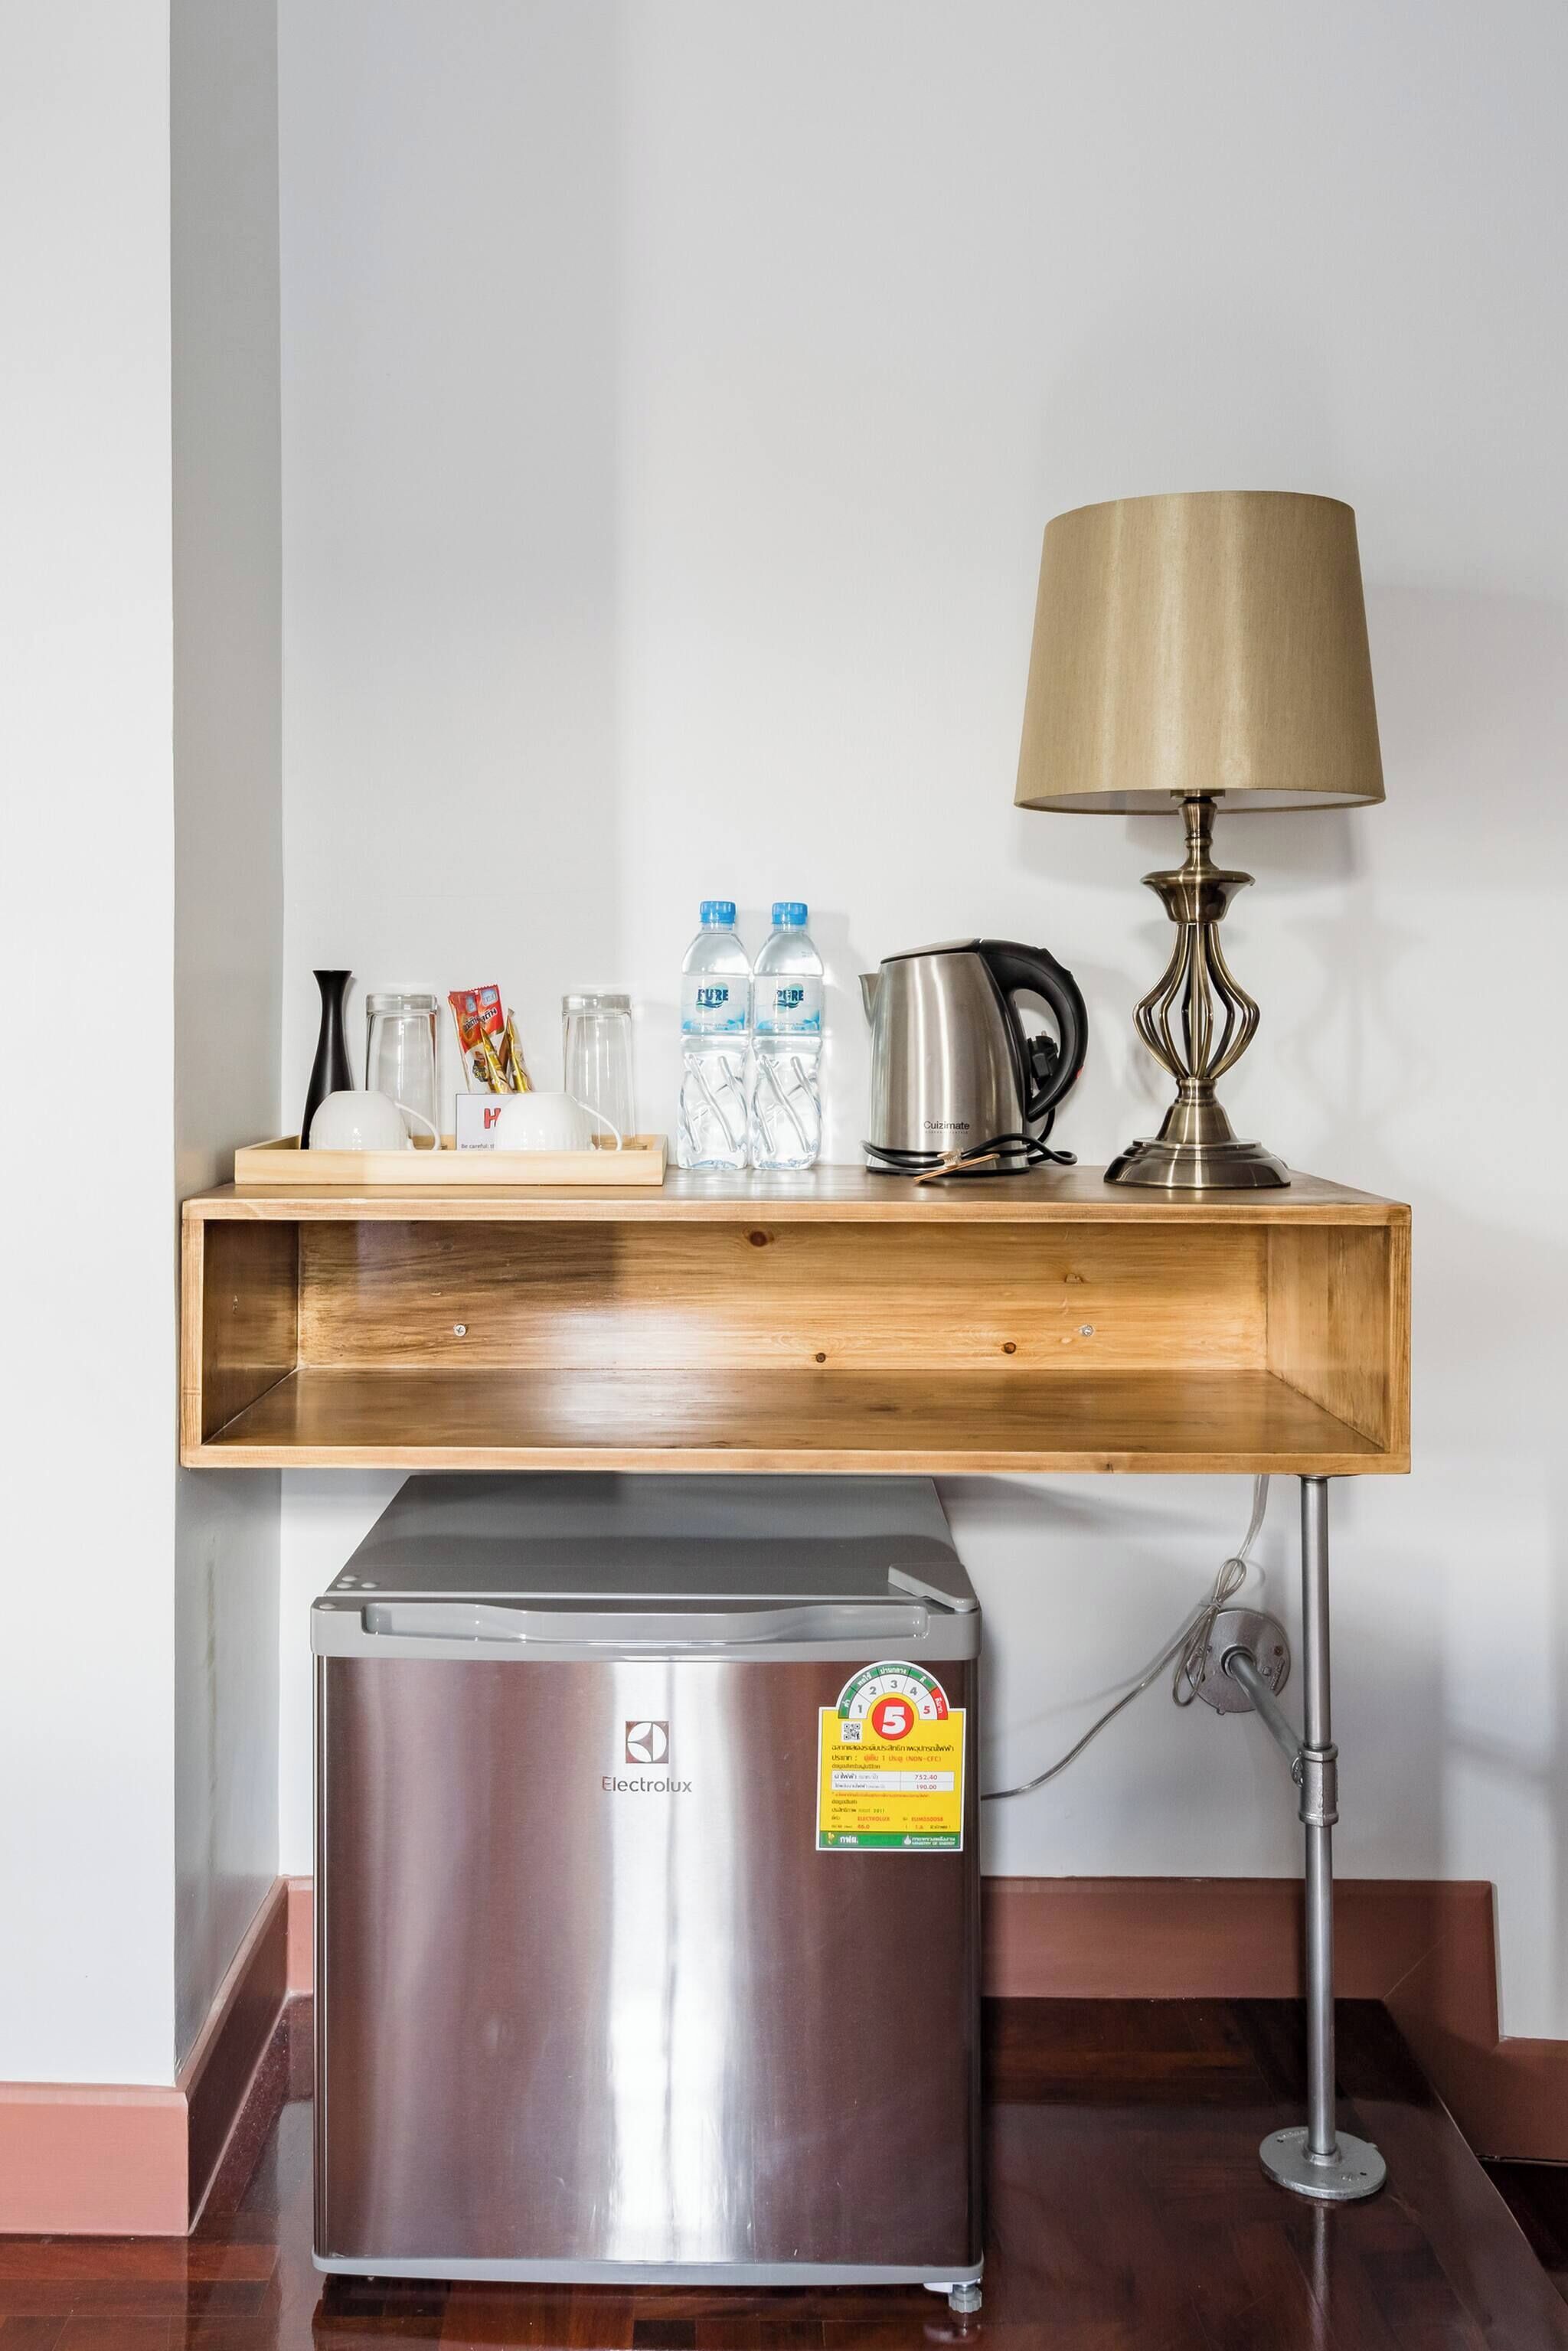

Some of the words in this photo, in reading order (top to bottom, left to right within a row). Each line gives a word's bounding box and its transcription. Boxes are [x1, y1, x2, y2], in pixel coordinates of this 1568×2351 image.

[697, 988, 729, 1001] PURE
[923, 1120, 970, 1130] Cuizimate
[890, 1680, 898, 1689] 3
[869, 1687, 877, 1696] 2
[910, 1687, 918, 1696] 4
[858, 1704, 863, 1714] 1
[923, 1705, 931, 1715] 5
[881, 1706, 906, 1735] 5
[602, 1775, 693, 1793] Electrolux
